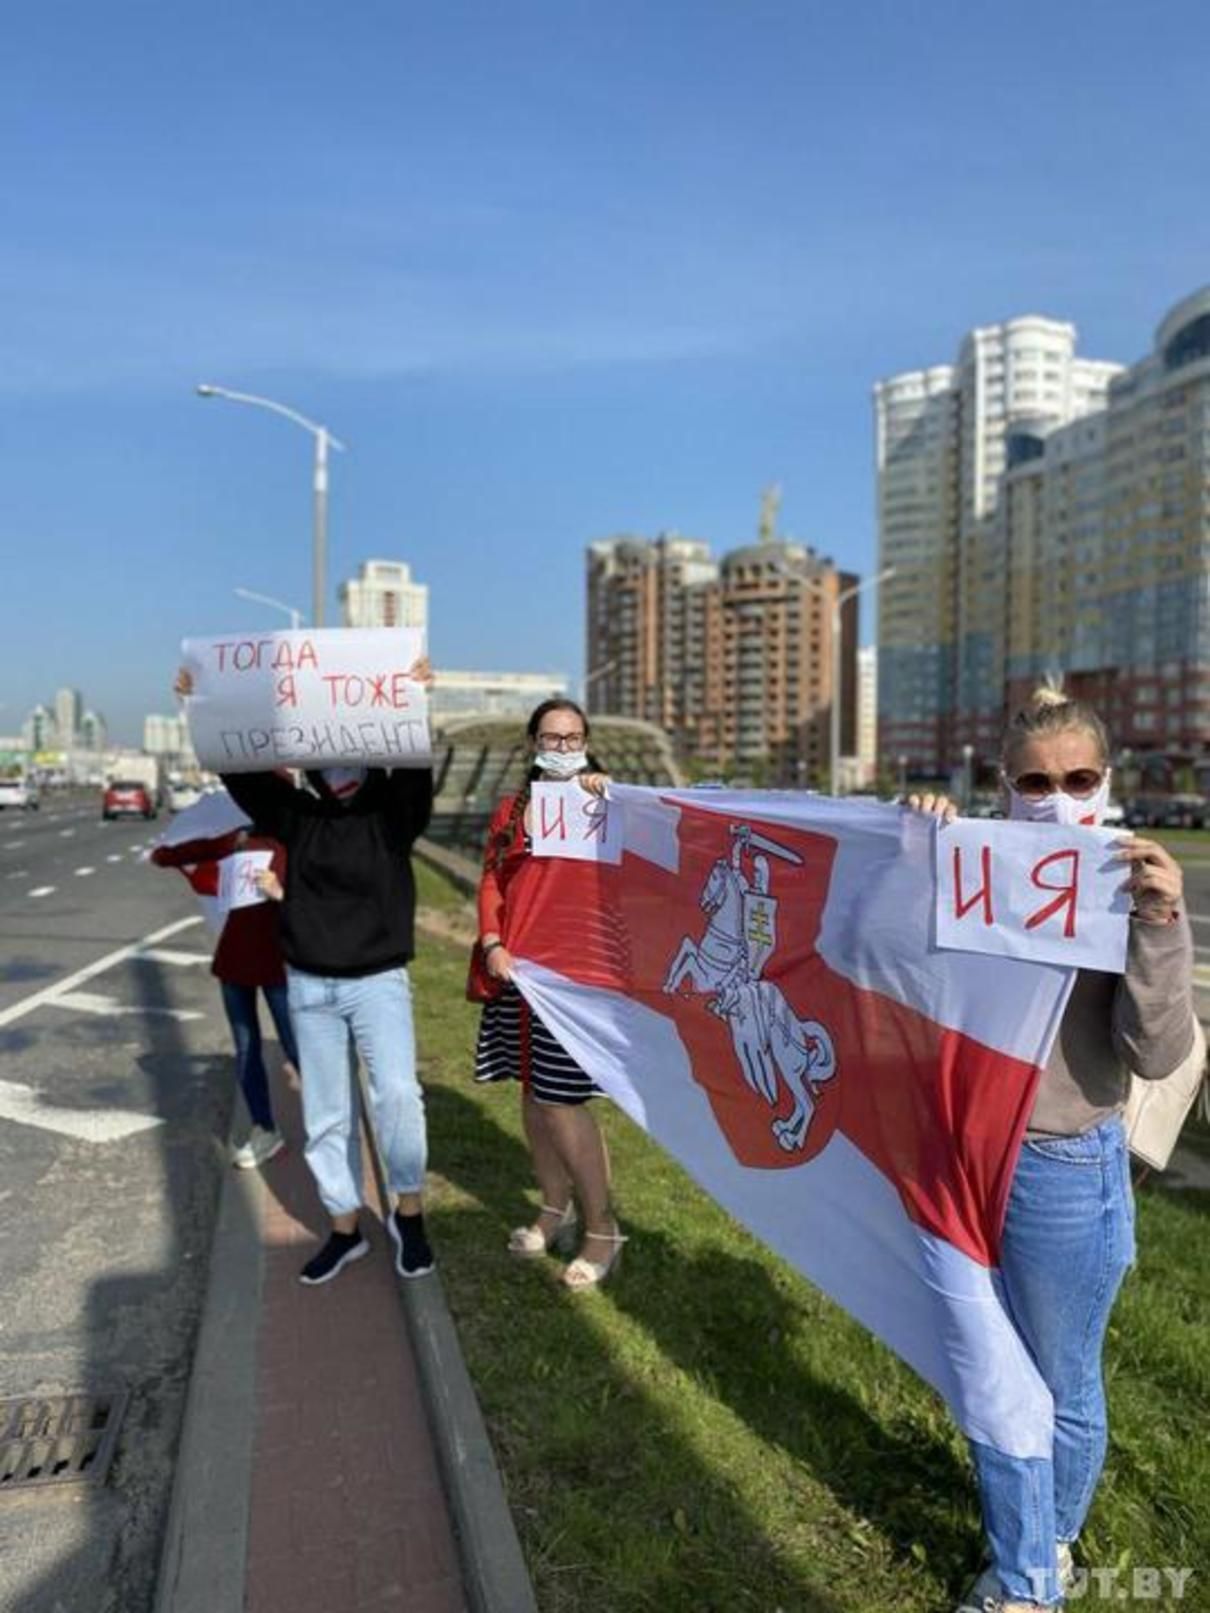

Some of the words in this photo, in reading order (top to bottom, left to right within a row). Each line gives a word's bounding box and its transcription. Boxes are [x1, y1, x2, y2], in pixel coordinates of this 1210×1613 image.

[213, 640, 317, 672] ТОГДА
[276, 675, 297, 707] Я
[322, 673, 410, 709] ТОЖЕ
[220, 720, 422, 759] ПРЕЗИДЕНТ
[541, 796, 566, 841] И
[582, 797, 608, 844] Я
[953, 846, 993, 925] И
[1024, 849, 1078, 938] Я
